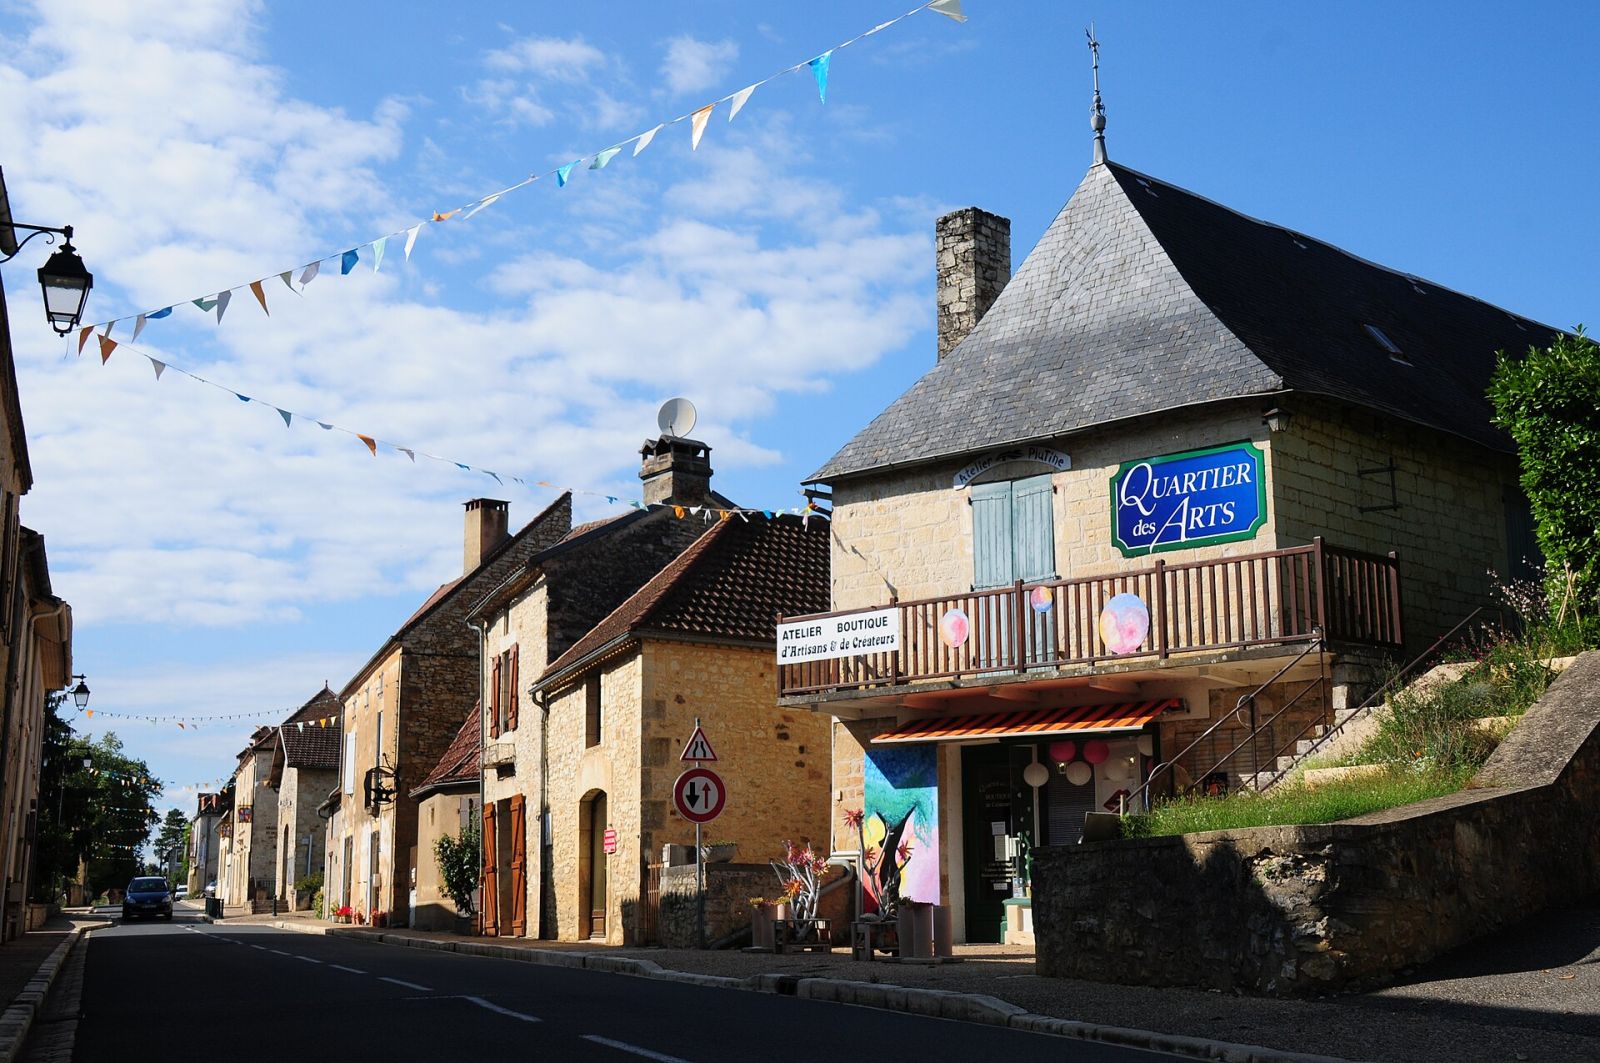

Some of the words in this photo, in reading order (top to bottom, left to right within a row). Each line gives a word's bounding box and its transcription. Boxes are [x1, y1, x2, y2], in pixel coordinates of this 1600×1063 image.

[959, 457, 992, 484] Atelier
[1118, 462, 1252, 516] QUARTIER
[1132, 519, 1156, 537] des
[1149, 496, 1235, 554] ARTS
[782, 626, 822, 640] ATELIER
[837, 616, 888, 633] BOUTIQUE
[781, 643, 827, 658] d'Artisans
[830, 640, 837, 652] &
[840, 638, 850, 650] de
[852, 634, 895, 648] Créateurs
